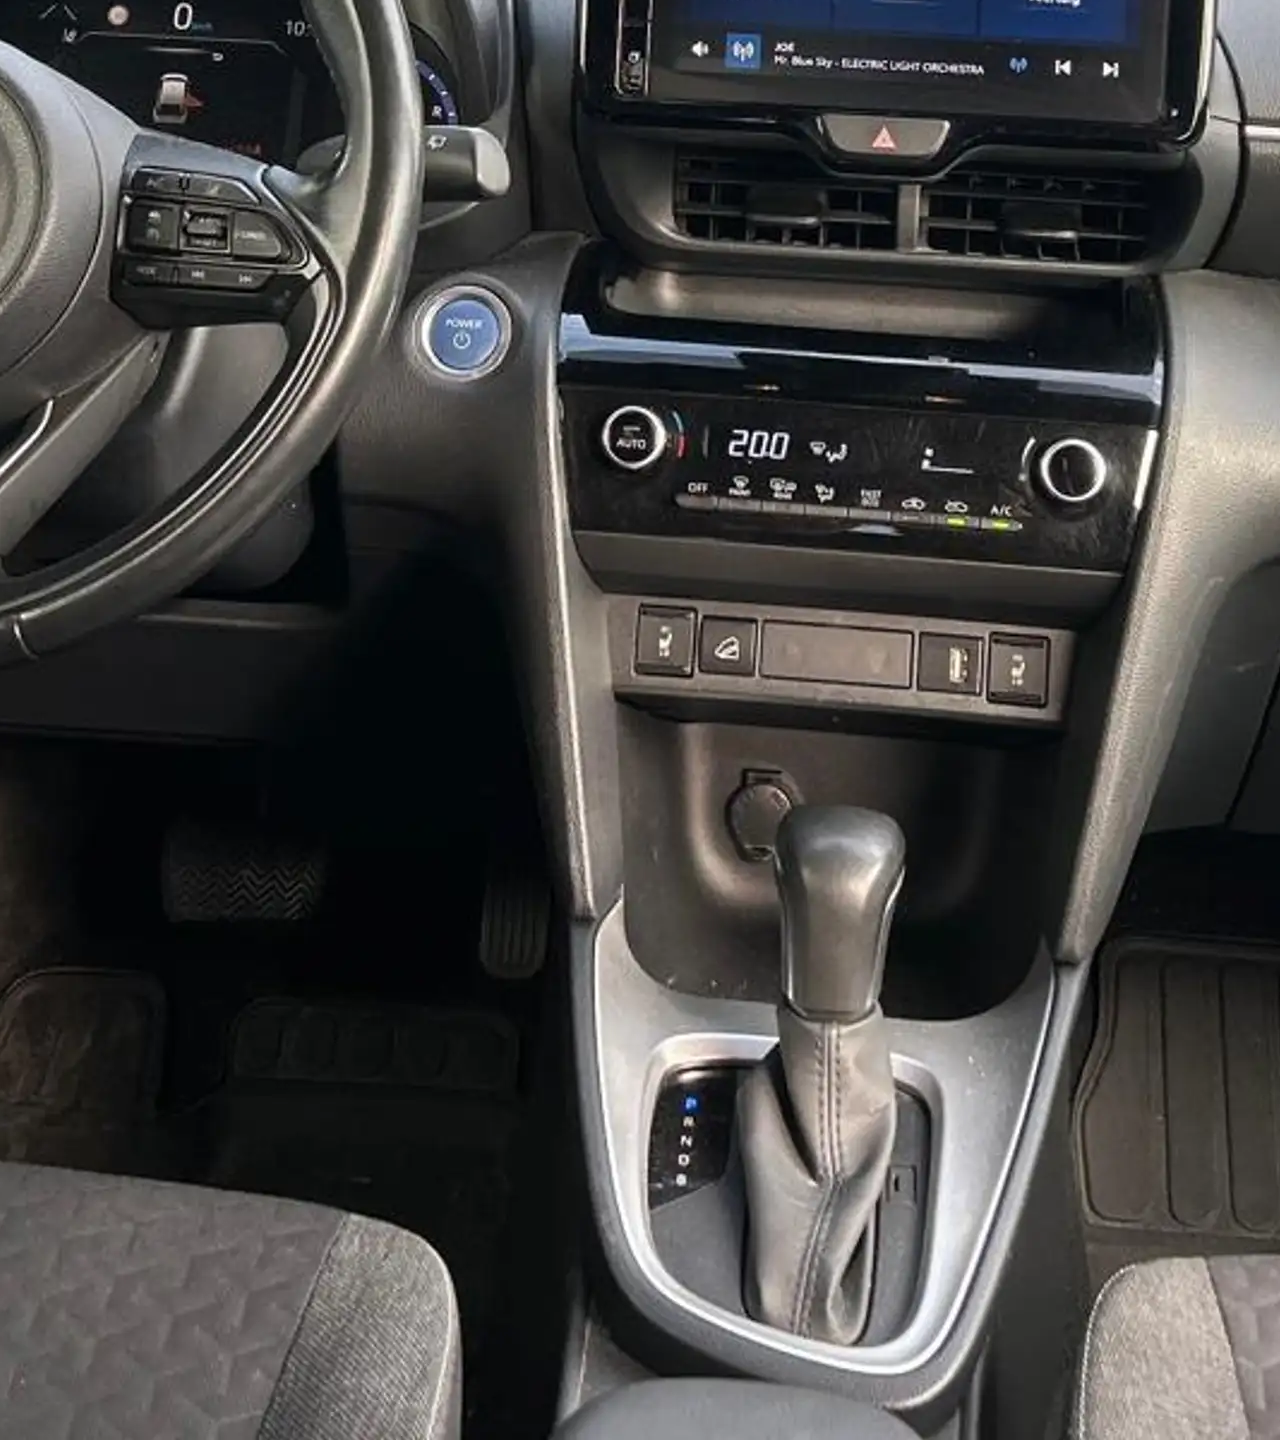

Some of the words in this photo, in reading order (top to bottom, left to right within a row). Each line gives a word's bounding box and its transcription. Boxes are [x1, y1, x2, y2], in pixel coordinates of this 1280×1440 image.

[173, 2, 194, 31] 0
[791, 56, 814, 66] Blue
[841, 58, 888, 71] ELECTRIC
[889, 61, 920, 72] LIGHT
[922, 62, 985, 75] ORCHESTRA
[445, 318, 484, 329] POWER
[616, 438, 647, 450] AUTO
[687, 482, 709, 494] OFF
[990, 504, 1013, 517] A/C
[685, 1096, 697, 1110] P
[681, 1135, 693, 1147] N
[678, 1154, 690, 1167] D
